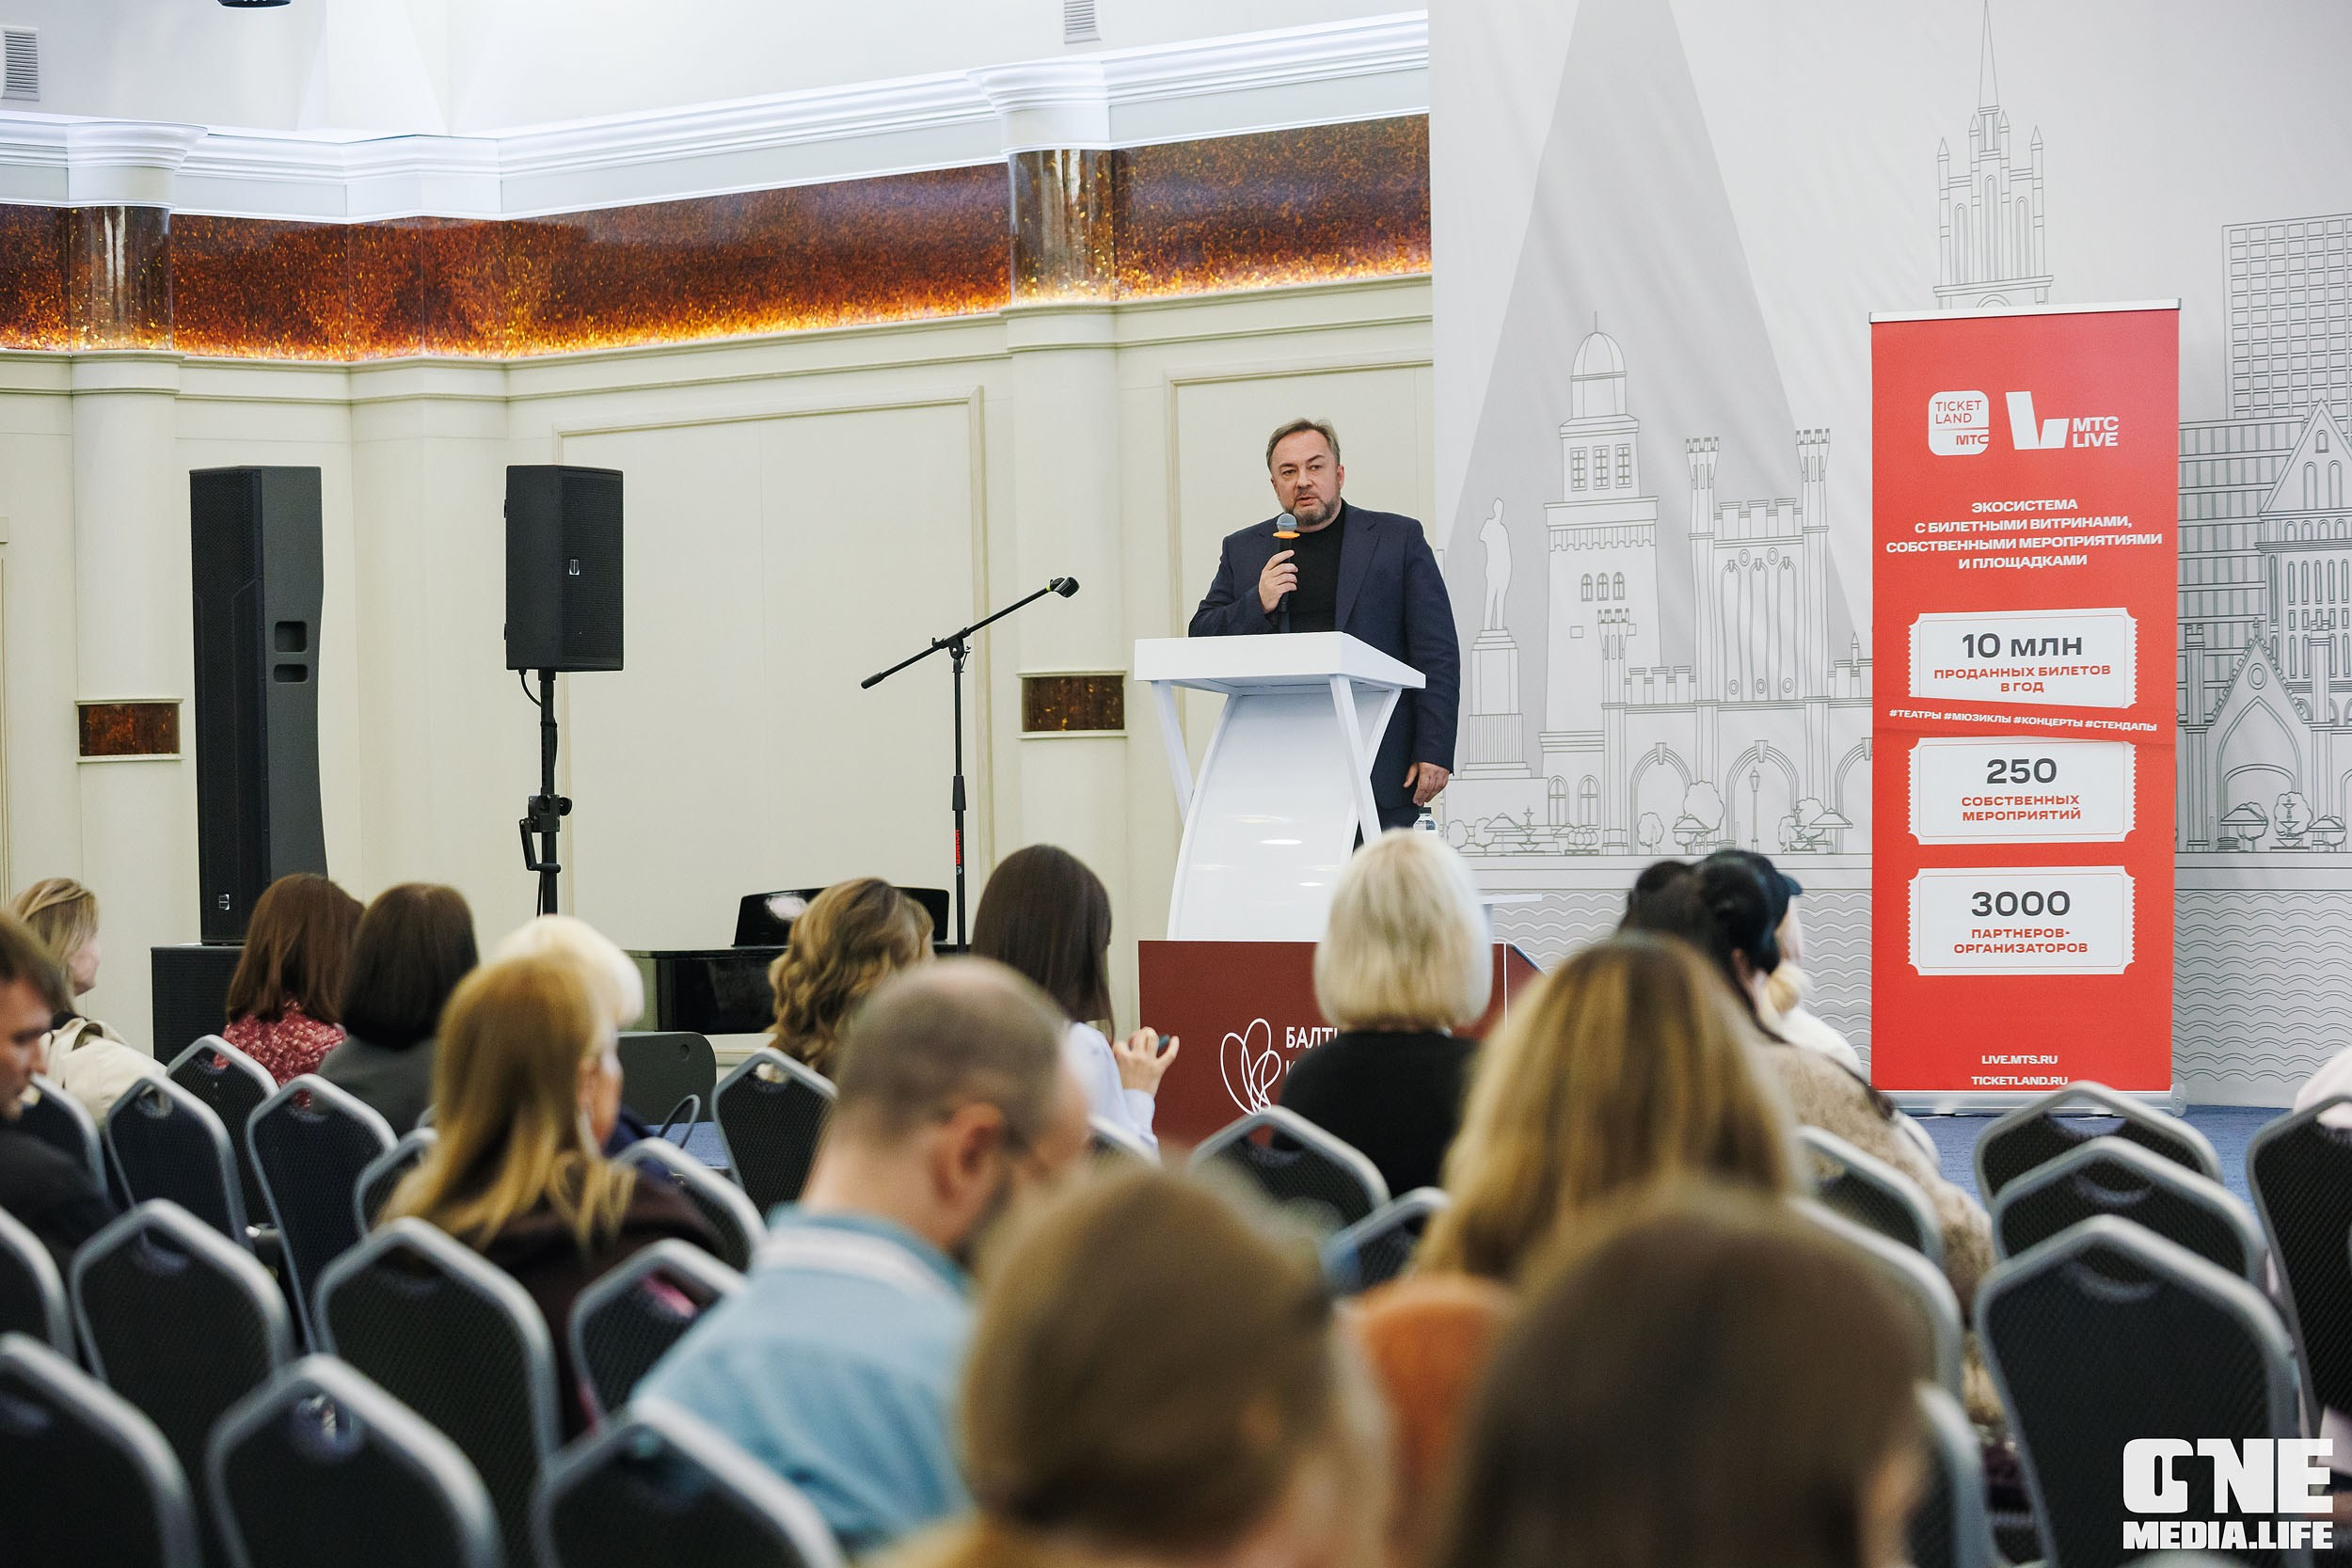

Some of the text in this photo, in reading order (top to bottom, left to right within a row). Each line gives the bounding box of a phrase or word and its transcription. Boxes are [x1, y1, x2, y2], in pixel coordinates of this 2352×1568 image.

[1935, 400, 1982, 412] TICKET
[1935, 413, 1973, 424] LAND
[2073, 432, 2119, 448] LIVE
[1972, 499, 2077, 514] ЭКОСИСТЕМА
[1915, 515, 2132, 533] С БИЛЕТНЫМИ ВИТРИНАМИ,
[1886, 533, 2162, 553] СОБСТВЕННЫМИ МЕРОПРИЯТИЯМИ
[1959, 555, 2088, 569] И ПЛОЩАДКАМИ
[1963, 633, 2001, 658] 10
[1933, 665, 2111, 680] ПРОДАННЫХ БИЛЕТОВ
[2001, 681, 2044, 693] В ГОД
[1889, 709, 2157, 732] #ТЕАТРЫ #МЮЗИКЛЫ #КОНЦЕРТЫ #СТЕНДАПЫ
[1987, 758, 2057, 784] 250
[1962, 795, 2080, 807] СОБСТВЕННЫХ
[1963, 809, 2081, 821] МЕРОПРИЯТИЙ
[1971, 891, 2070, 917] 3000
[1971, 927, 2070, 939] ПАРТНЕРОВ-
[1954, 942, 2088, 954] ОРГАНИЗАТОРОВ
[1981, 1054, 2058, 1065] LIVE.MTS.RU
[1971, 1075, 2068, 1086] TICKETLAND.RU
